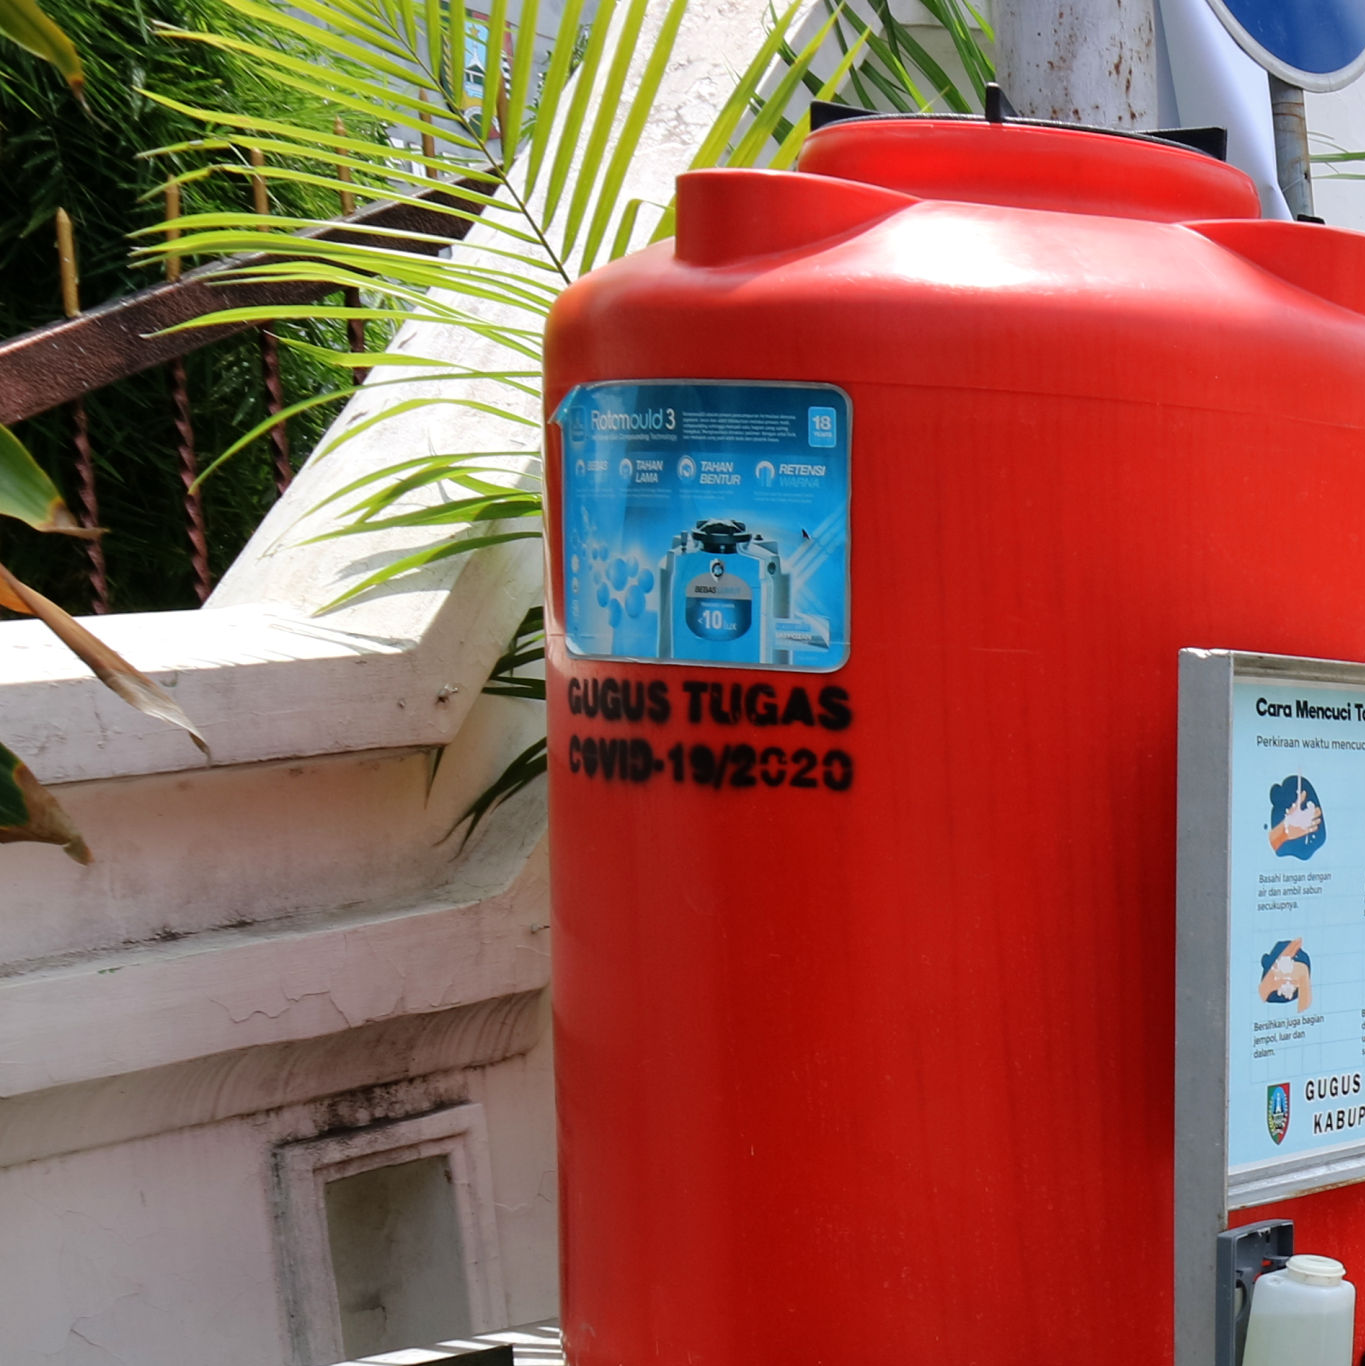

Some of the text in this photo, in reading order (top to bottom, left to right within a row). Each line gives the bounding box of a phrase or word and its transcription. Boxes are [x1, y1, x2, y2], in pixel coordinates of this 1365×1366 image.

[666, 408, 676, 430] 3
[813, 415, 831, 430] 18
[635, 460, 664, 471] TAHAN
[701, 460, 734, 472] TAHAN
[779, 463, 827, 476] RETENSI
[635, 472, 659, 483] LAMA
[700, 473, 741, 485] BENTUR
[568, 677, 854, 731] GUGUS TUGAS
[1256, 697, 1292, 718] Cara
[1295, 699, 1352, 721] Mencuci
[1256, 735, 1300, 749] Perkiraan
[1302, 738, 1330, 750] waktu
[568, 734, 854, 791] COVID-19/2020
[1259, 872, 1332, 885] Basahi tangan dengan
[1268, 887, 1281, 897] dan
[1286, 1017, 1301, 1029] juga
[1301, 1014, 1325, 1026] bagian
[1292, 1029, 1306, 1040] dan
[1305, 1073, 1362, 1101] GUGUS
